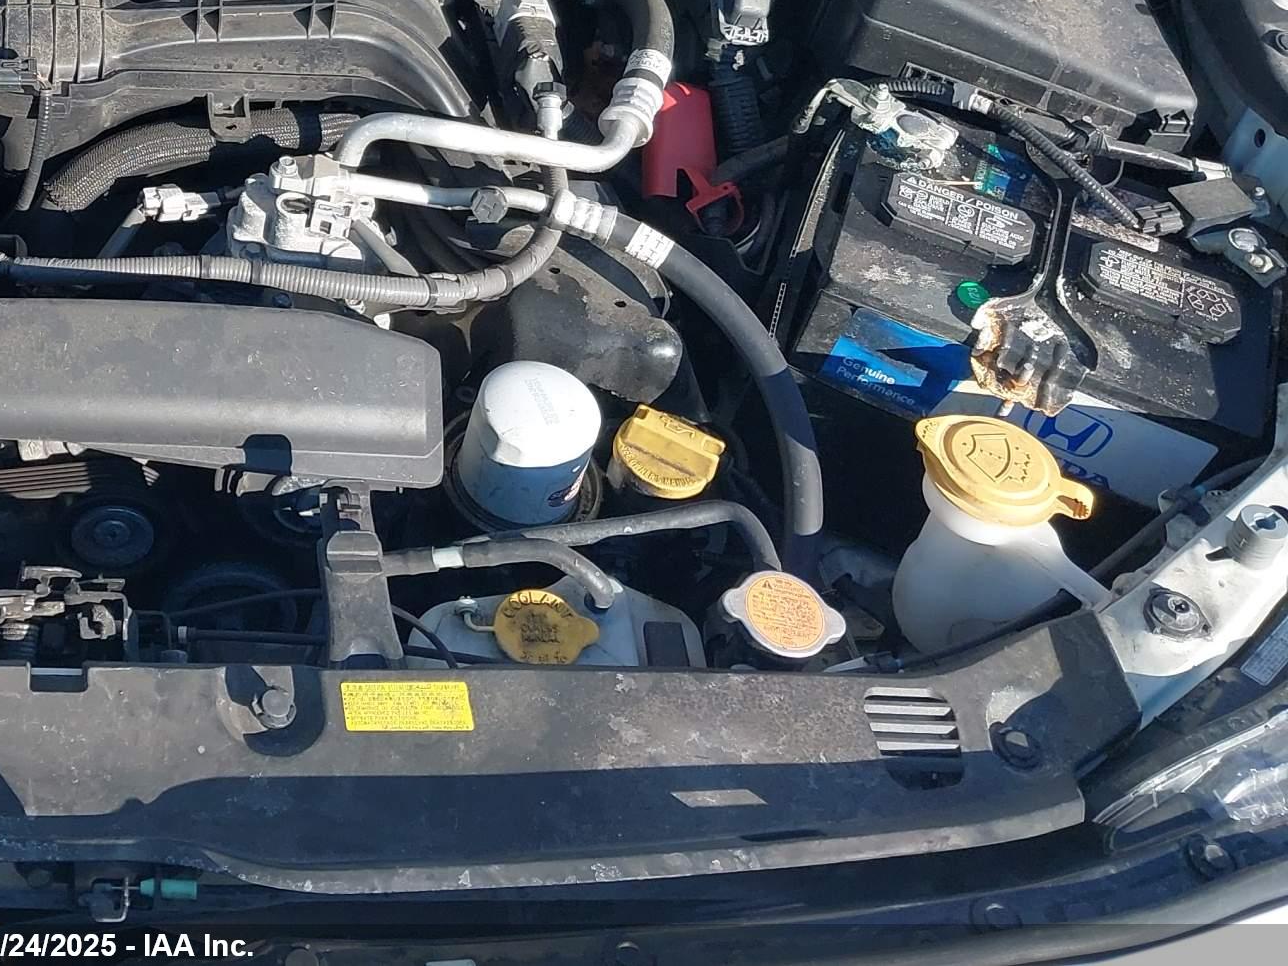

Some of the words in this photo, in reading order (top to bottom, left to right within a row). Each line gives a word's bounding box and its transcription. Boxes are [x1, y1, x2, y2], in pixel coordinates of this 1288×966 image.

[918, 179, 964, 202] DANGER
[976, 199, 1019, 220] POISON
[835, 365, 916, 406] Performance
[842, 356, 896, 385] Genuine
[503, 591, 573, 619] COOLANT
